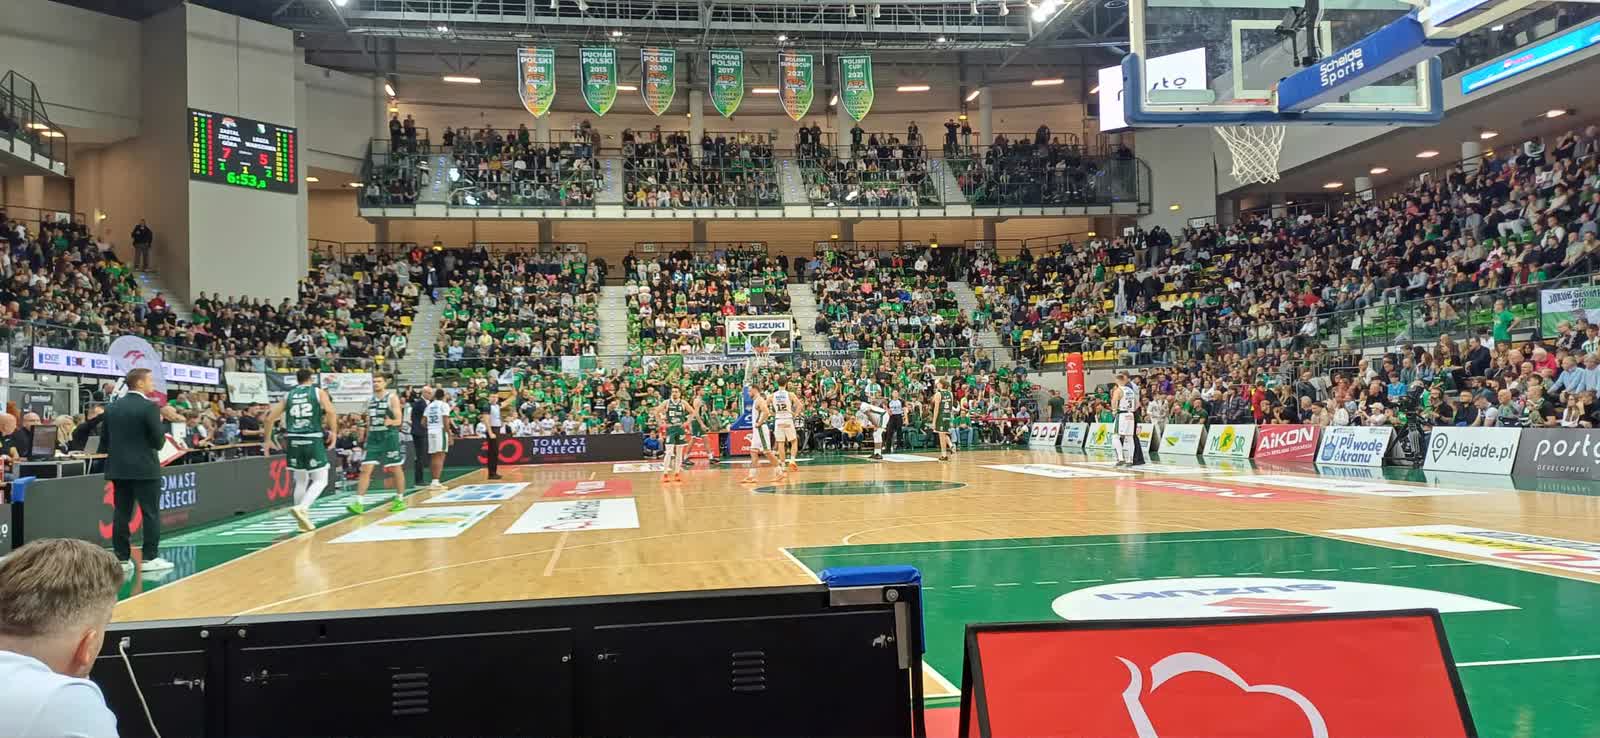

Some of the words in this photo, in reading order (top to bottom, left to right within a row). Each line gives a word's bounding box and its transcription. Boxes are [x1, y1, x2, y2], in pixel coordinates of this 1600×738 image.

[1320, 47, 1363, 76] Schelde
[1320, 58, 1365, 87] Sports
[223, 148, 231, 158] 7
[259, 154, 268, 165] 5
[748, 322, 785, 330] SUZUKI
[290, 403, 313, 418] 42
[429, 415, 439, 424] 32
[533, 437, 587, 447] TOMASZ
[1353, 439, 1383, 455] wodę
[1340, 449, 1372, 463] kranu
[1447, 441, 1513, 461] Alejade.pl
[160, 472, 196, 490] OMASZ
[1092, 583, 1337, 601] SUZUKI
